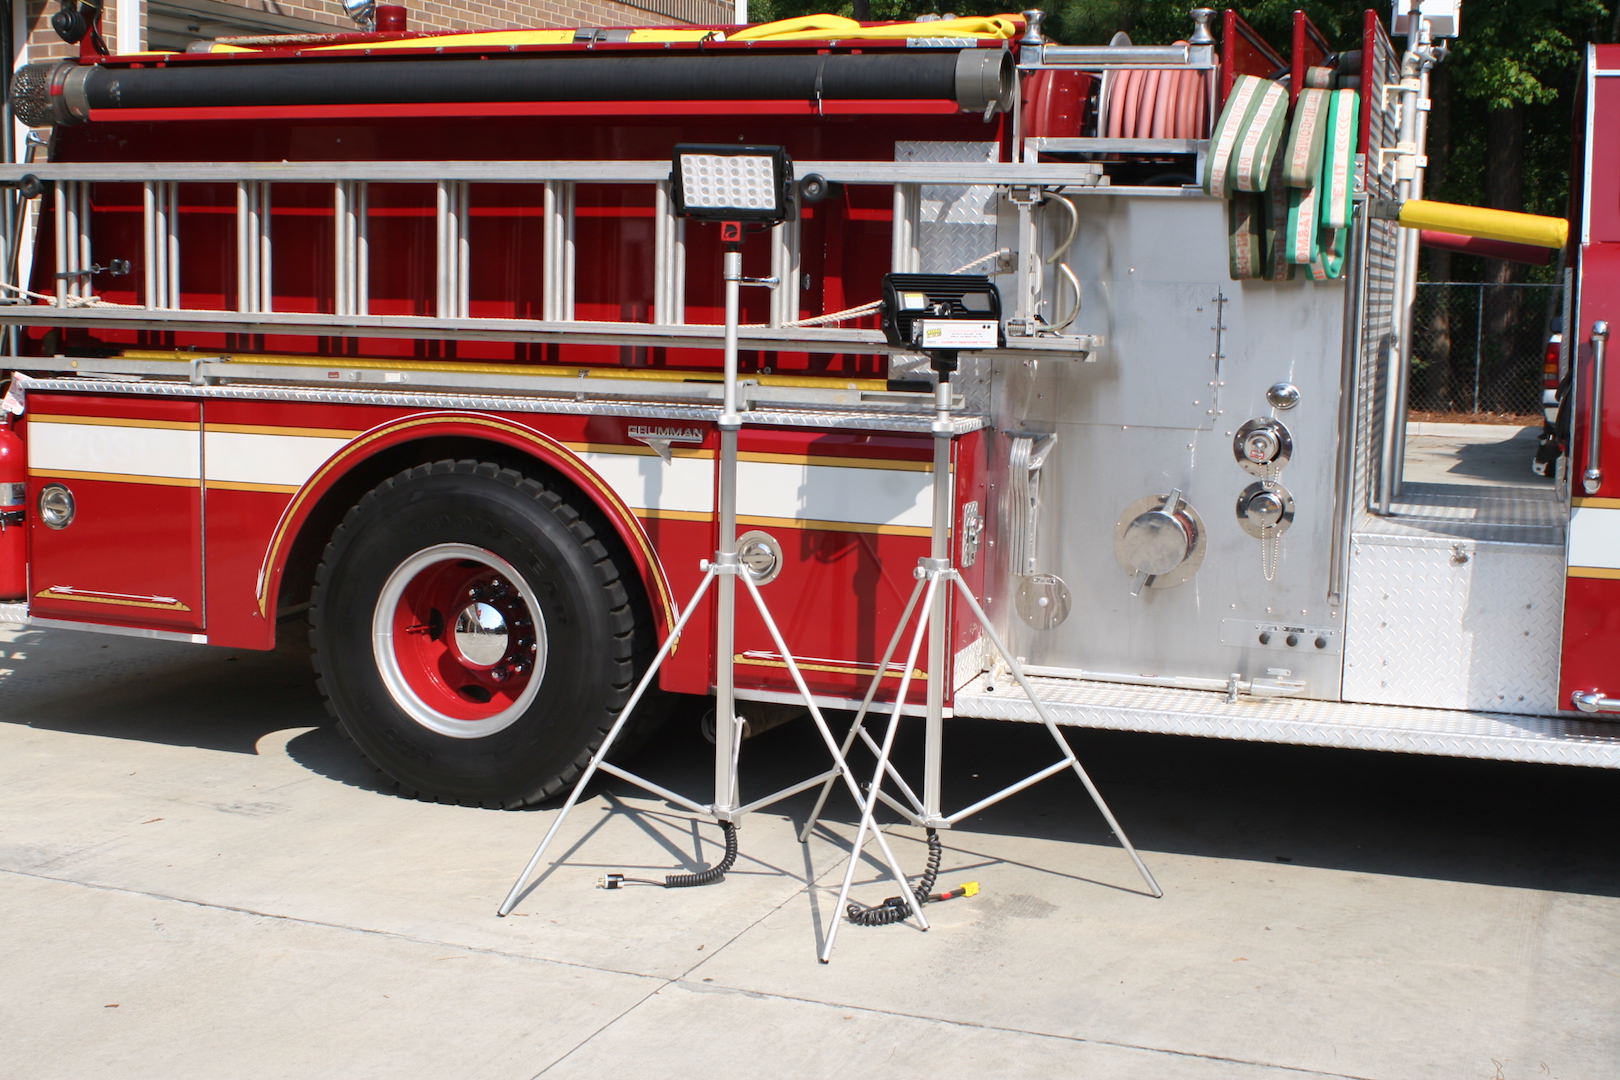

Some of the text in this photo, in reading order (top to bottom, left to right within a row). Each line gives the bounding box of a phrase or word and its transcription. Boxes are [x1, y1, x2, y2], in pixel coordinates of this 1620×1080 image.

[1333, 162, 1345, 197] EXIT
[1295, 210, 1311, 263] OMBAT
[628, 425, 703, 438] GRUMMAN
